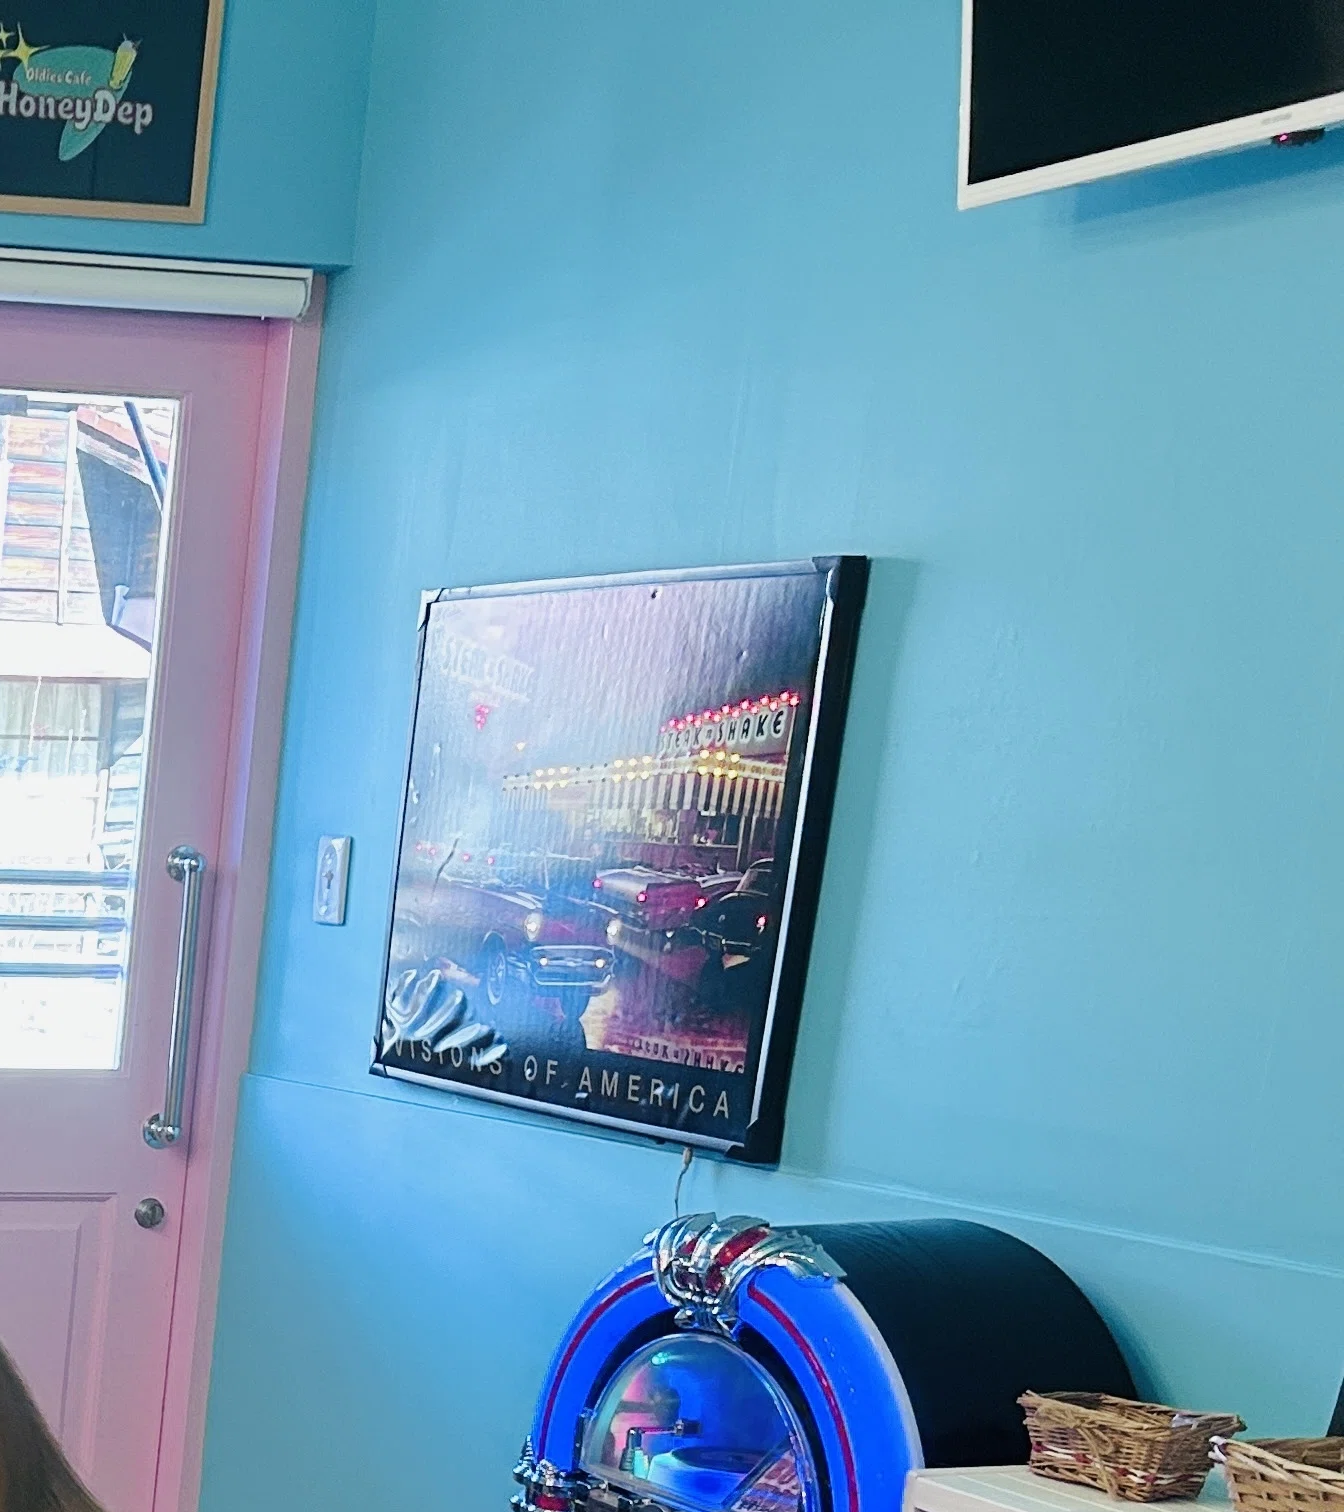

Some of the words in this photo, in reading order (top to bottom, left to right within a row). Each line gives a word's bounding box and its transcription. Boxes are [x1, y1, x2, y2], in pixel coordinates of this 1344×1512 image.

[26, 67, 62, 84] Oldies
[65, 69, 92, 86] Cafe
[716, 710, 784, 743] SHAKE
[393, 1037, 504, 1076] VISIONS
[523, 1054, 559, 1085] OF
[578, 1065, 730, 1120] AMERICA
